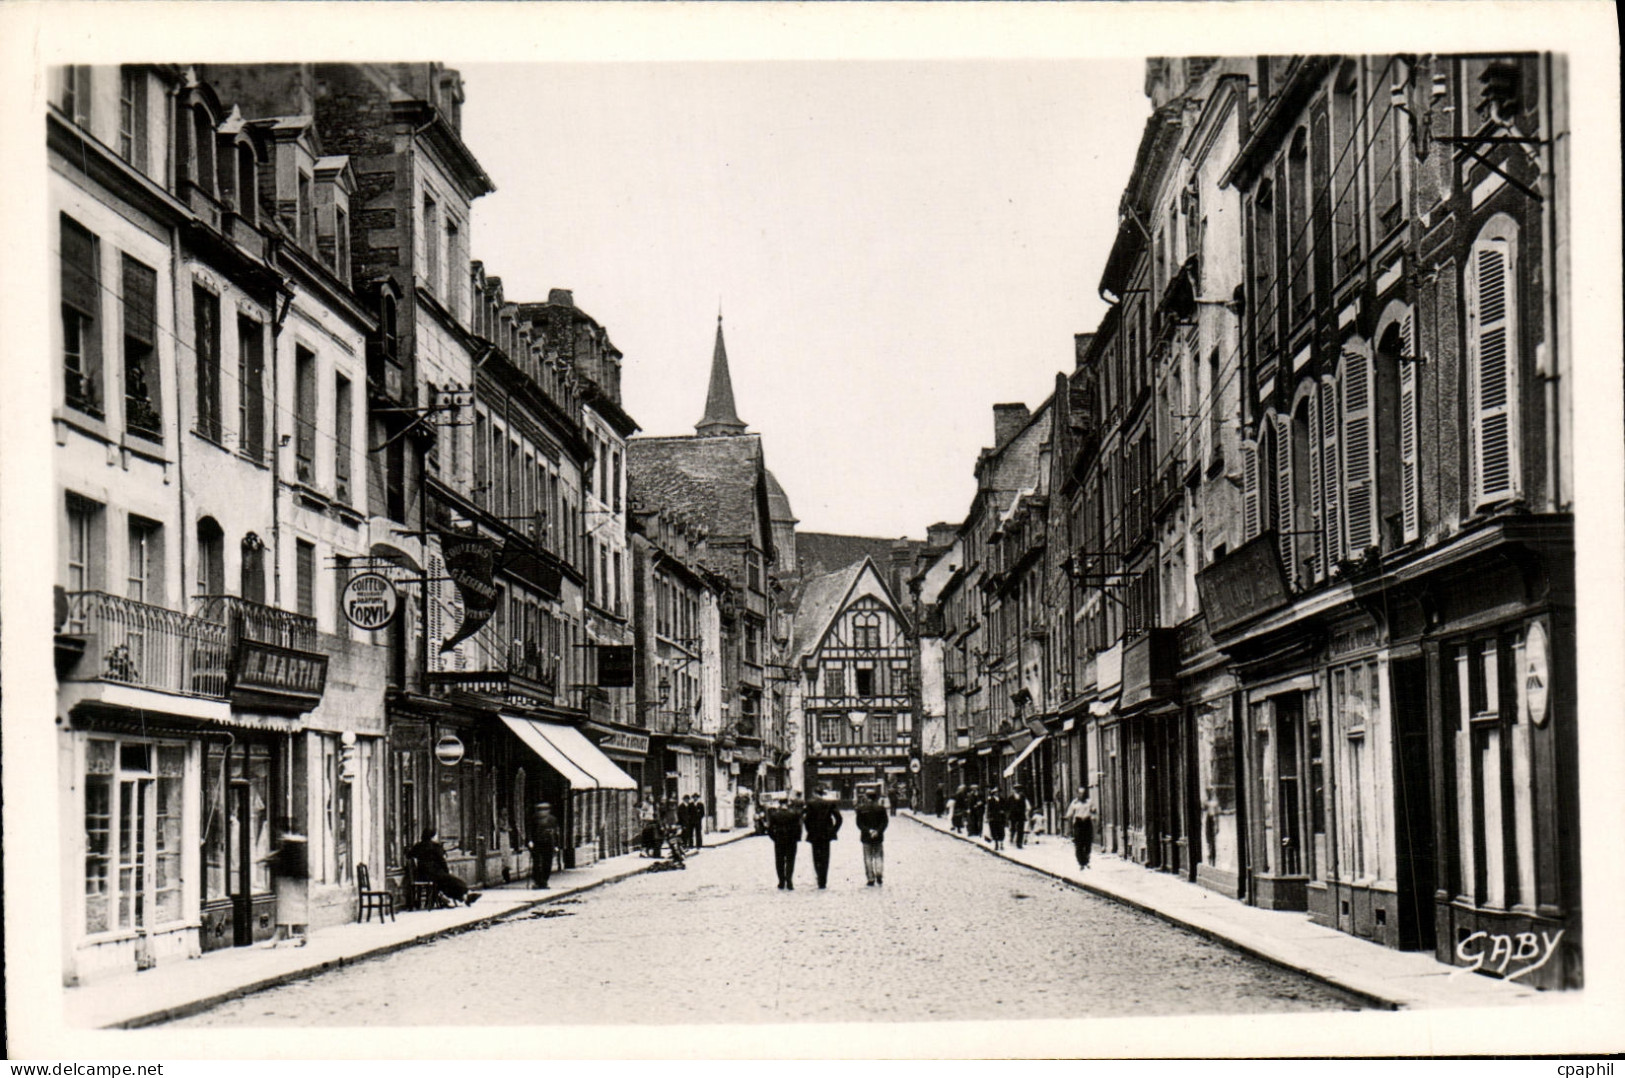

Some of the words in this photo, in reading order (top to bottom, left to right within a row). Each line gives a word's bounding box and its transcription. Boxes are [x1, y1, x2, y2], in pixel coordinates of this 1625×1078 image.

[351, 577, 387, 592] COIFFEUR
[349, 600, 391, 626] FORVIL
[263, 653, 321, 691] MARTIN
